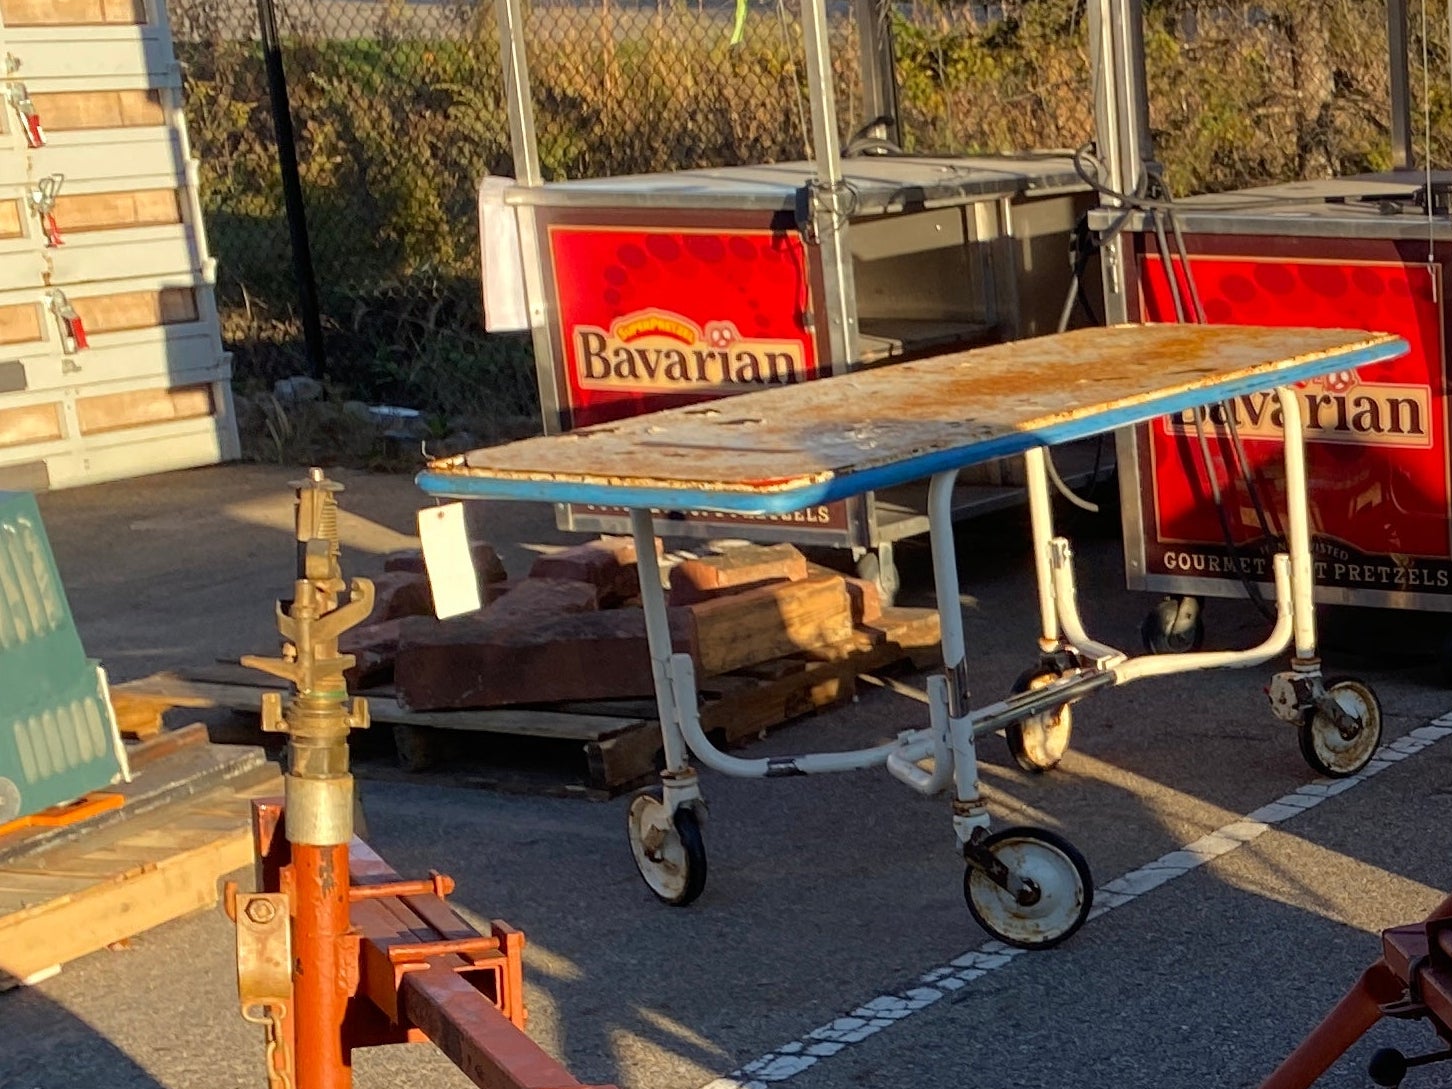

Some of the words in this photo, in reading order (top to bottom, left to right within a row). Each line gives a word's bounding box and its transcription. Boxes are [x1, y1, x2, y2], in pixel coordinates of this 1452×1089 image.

[580, 331, 798, 384] Bavarian
[1164, 551, 1267, 576] GOURMET
[1333, 563, 1450, 588] PRETZELS
